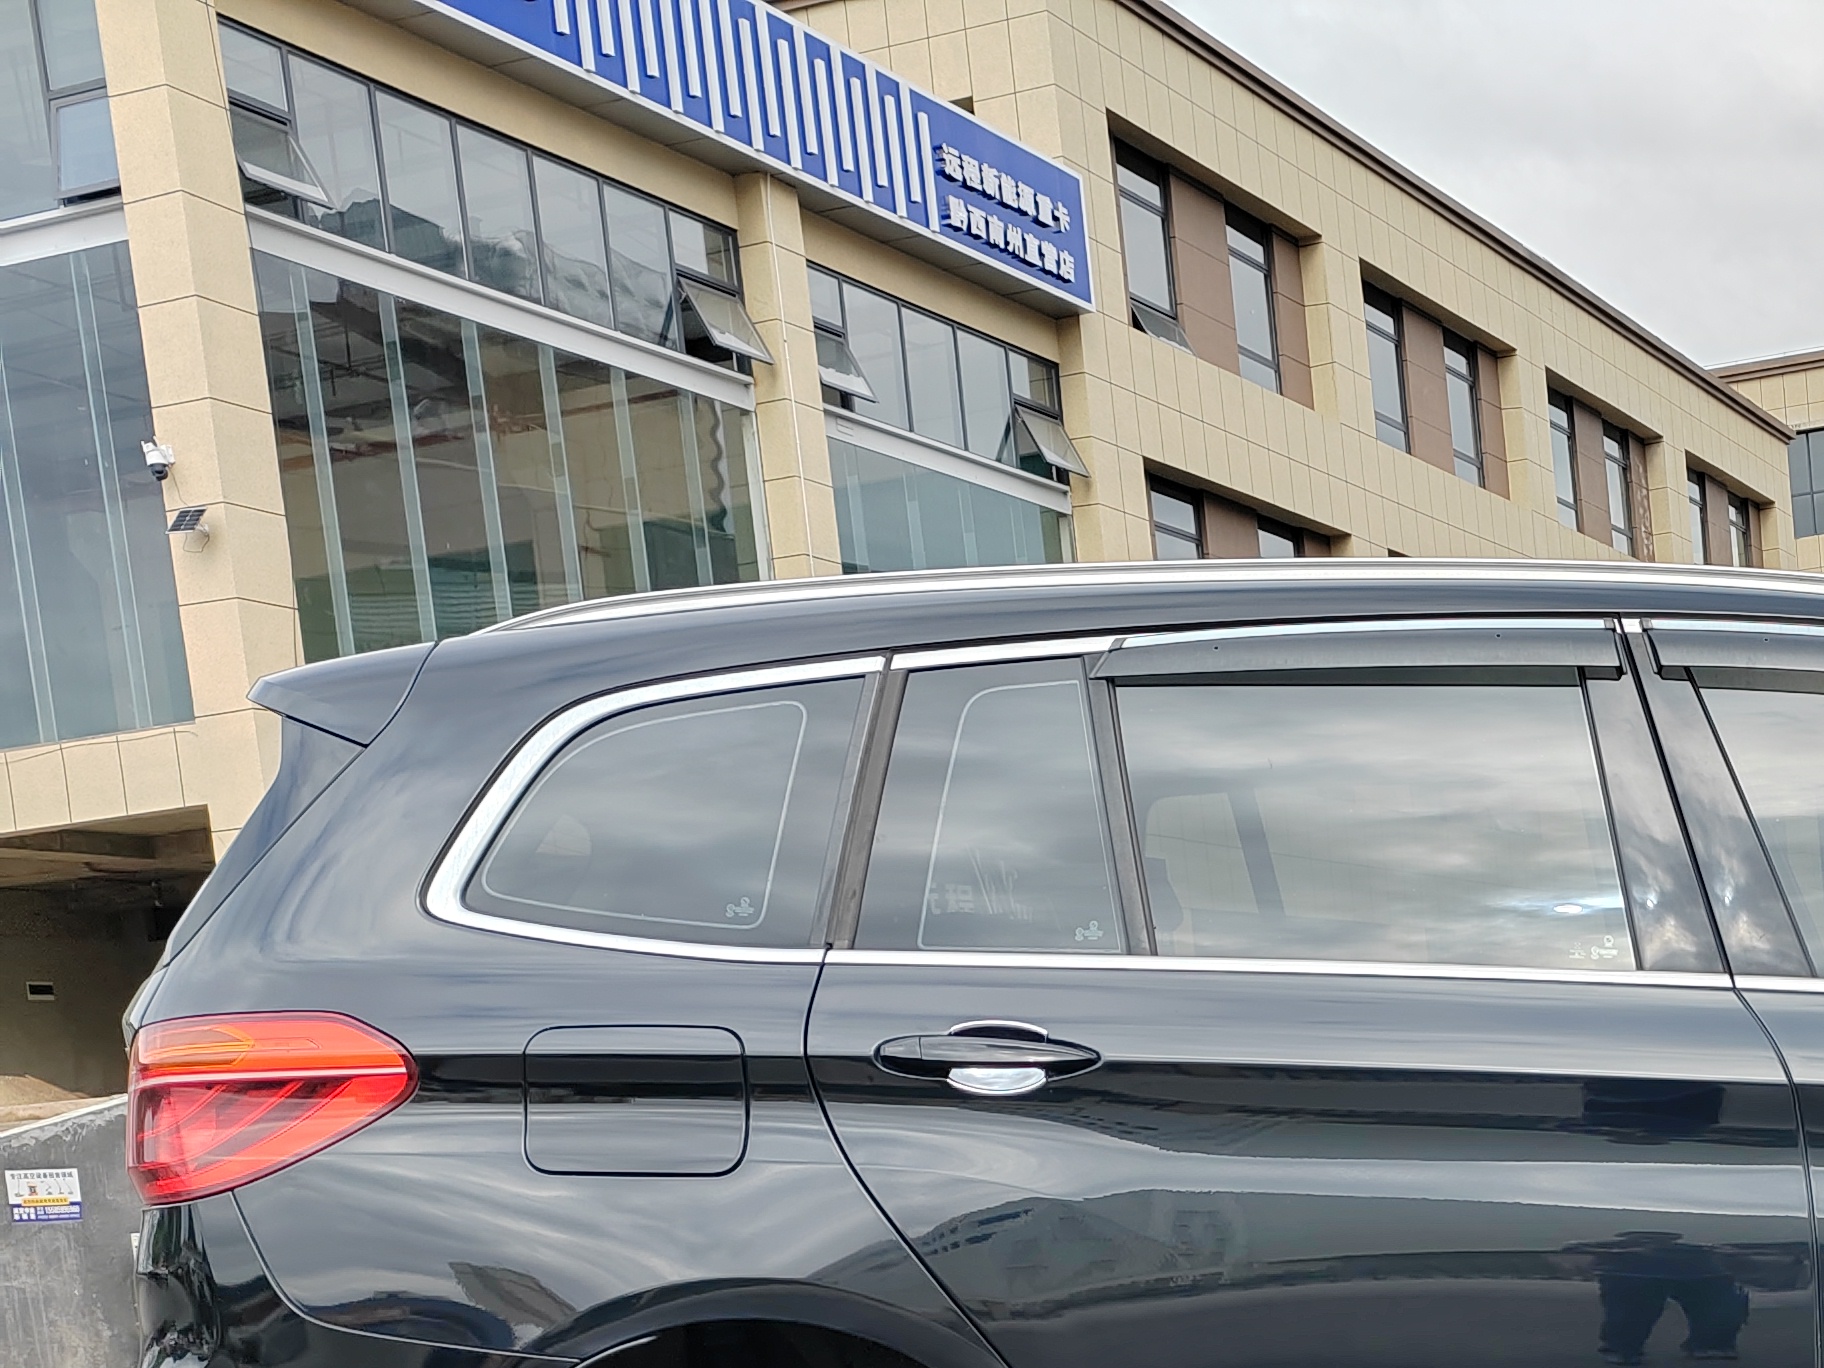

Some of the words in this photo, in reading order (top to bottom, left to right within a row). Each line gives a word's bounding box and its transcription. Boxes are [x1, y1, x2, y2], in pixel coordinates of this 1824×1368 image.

[941, 143, 1071, 233] 远程新能源重卡
[947, 195, 1075, 282] 黔西南州直营店
